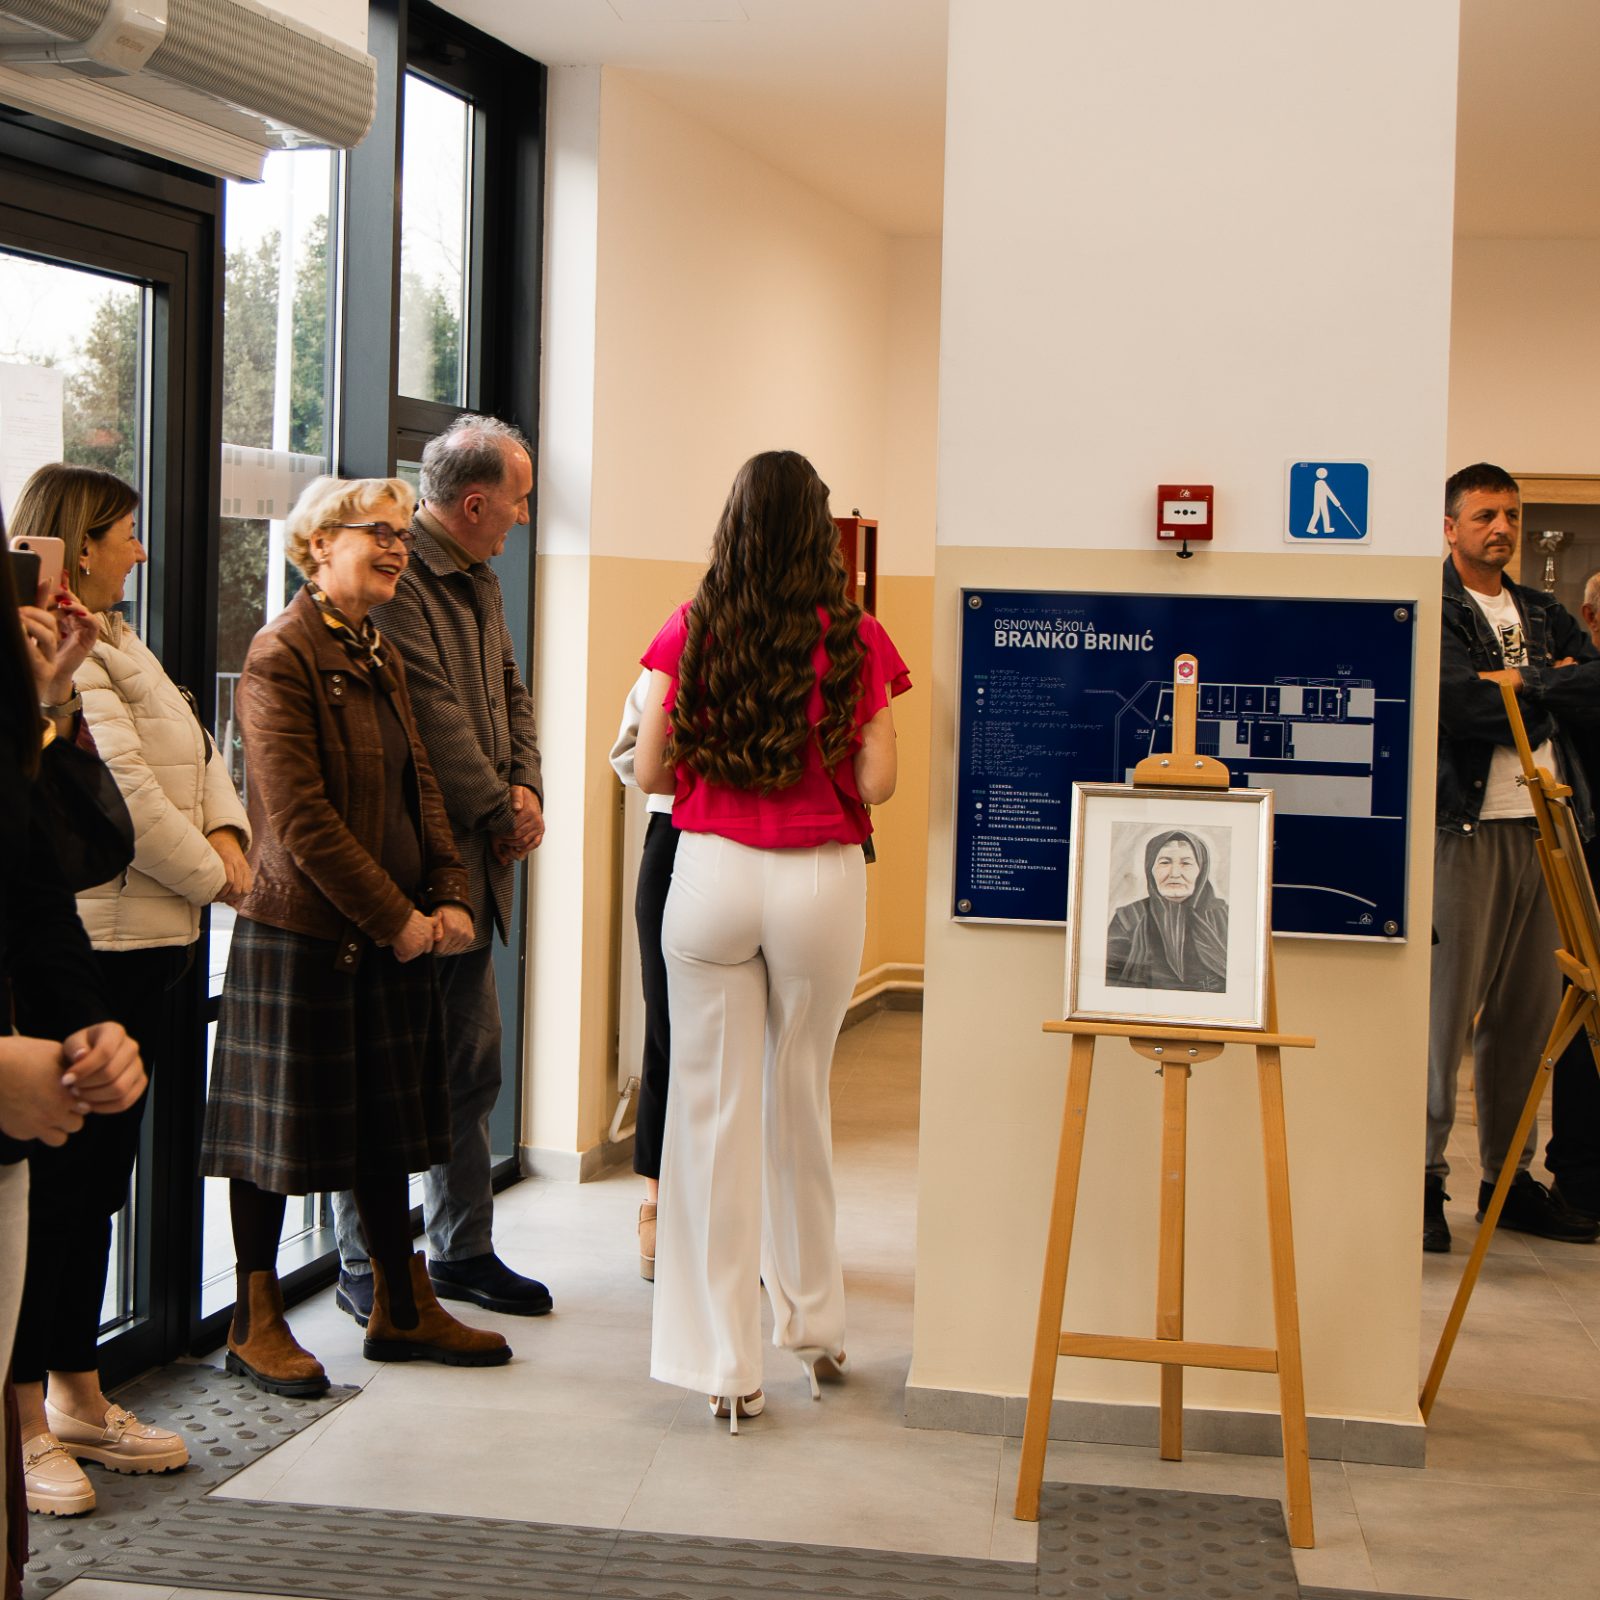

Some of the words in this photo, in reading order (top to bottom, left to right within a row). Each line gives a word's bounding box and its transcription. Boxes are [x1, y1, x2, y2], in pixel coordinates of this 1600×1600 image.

[994, 619, 1052, 632] OSNOVNA
[1055, 618, 1095, 632] ŠKOLA
[994, 631, 1078, 649] BRANKO
[1084, 630, 1154, 651] BRINIĆ
